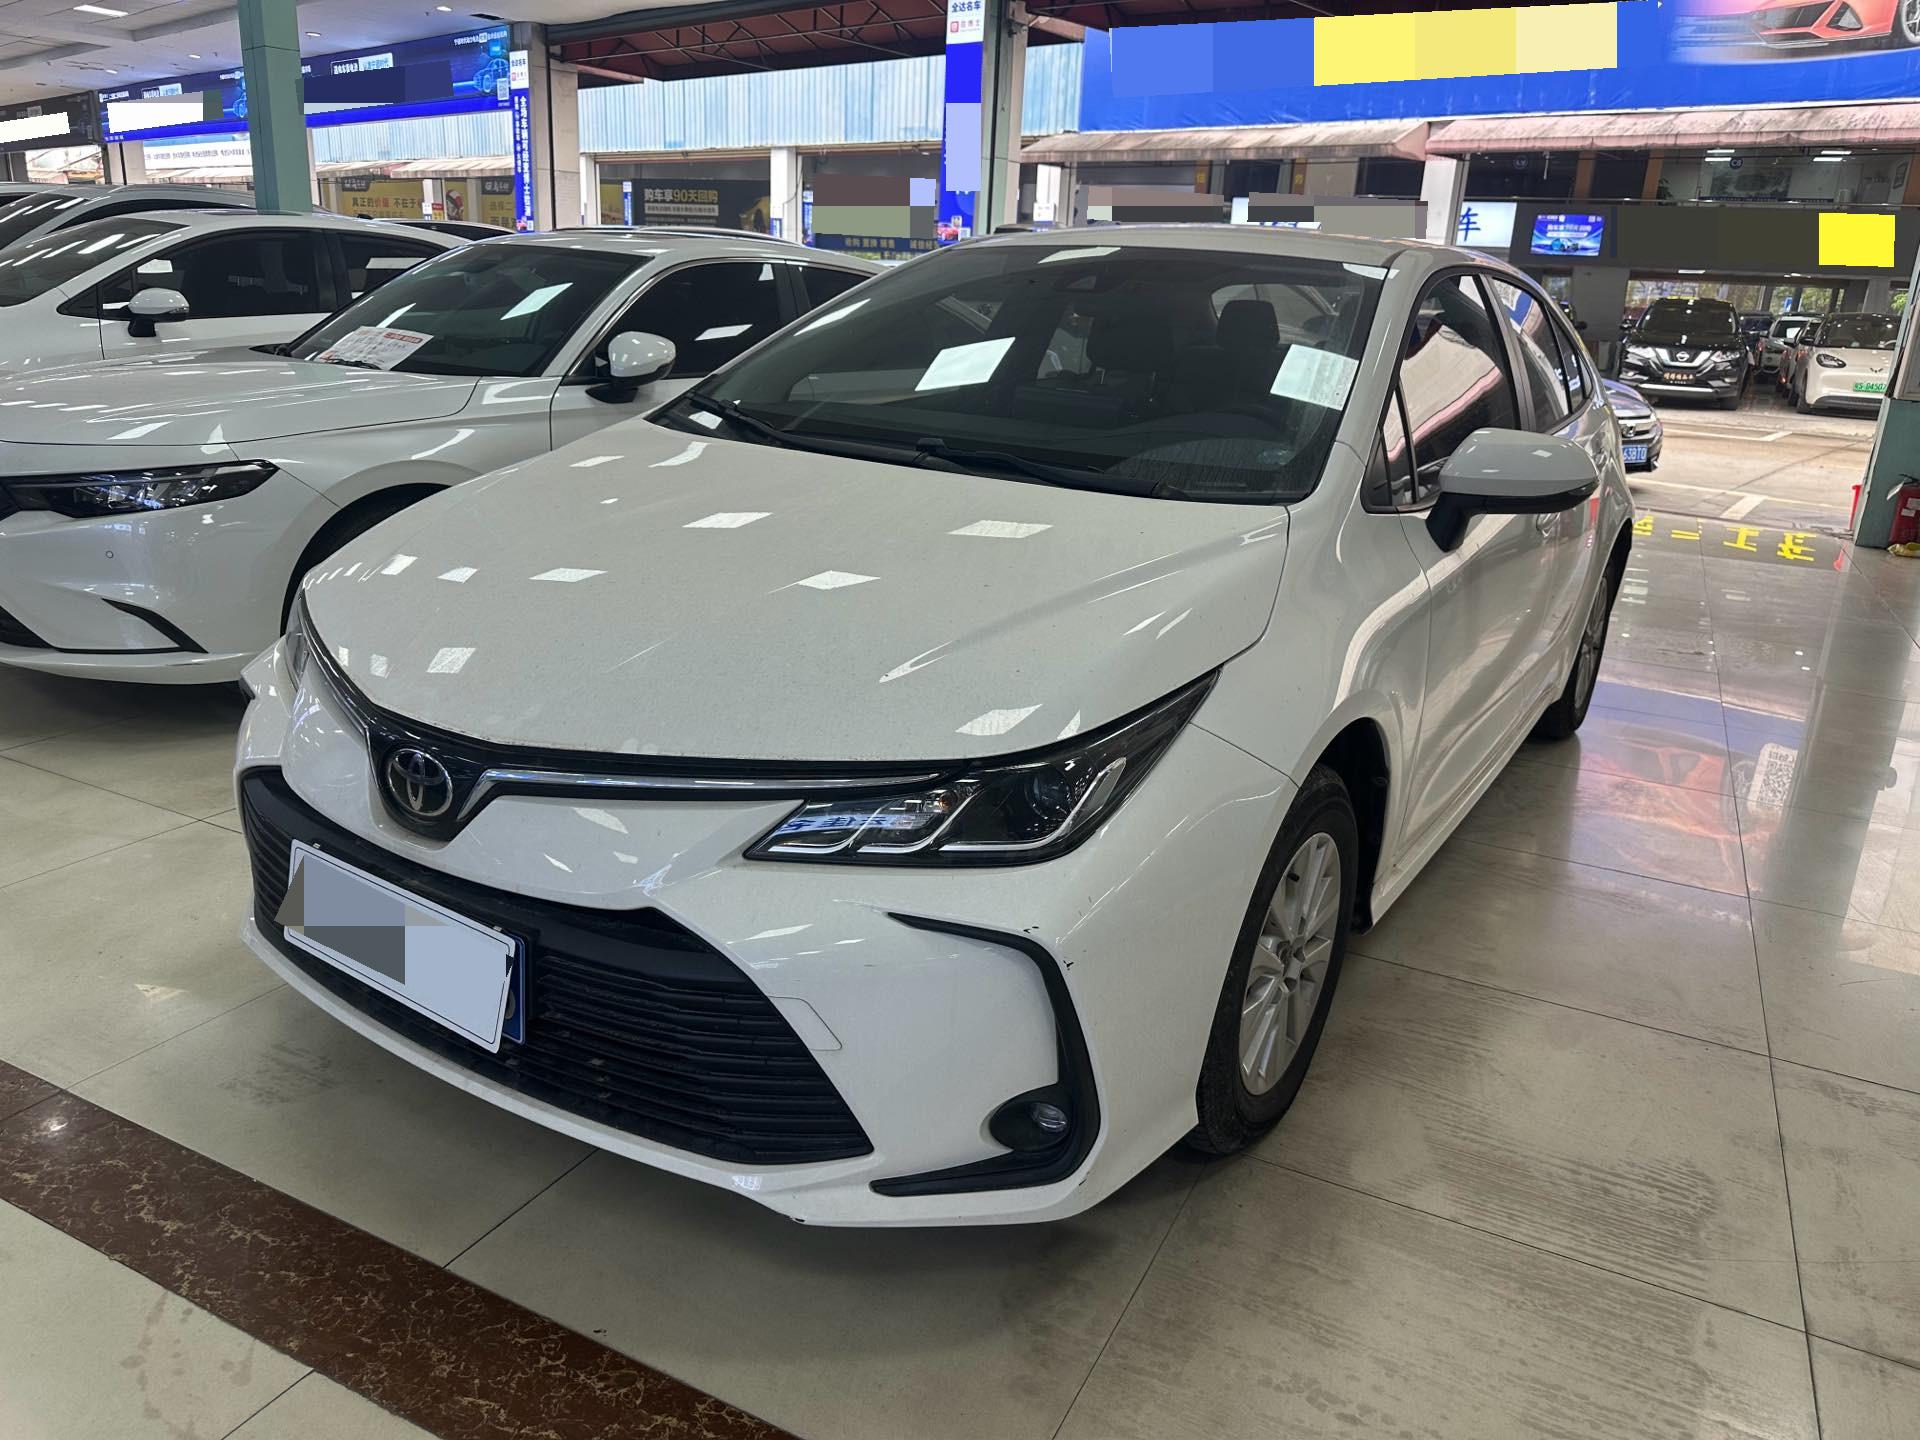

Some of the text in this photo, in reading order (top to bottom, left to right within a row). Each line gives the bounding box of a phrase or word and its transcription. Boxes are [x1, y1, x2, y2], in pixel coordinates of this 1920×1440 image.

[951, 0, 981, 13] 全达名车
[644, 188, 718, 204] 购车享90天回购
[1458, 207, 1481, 241] 车
